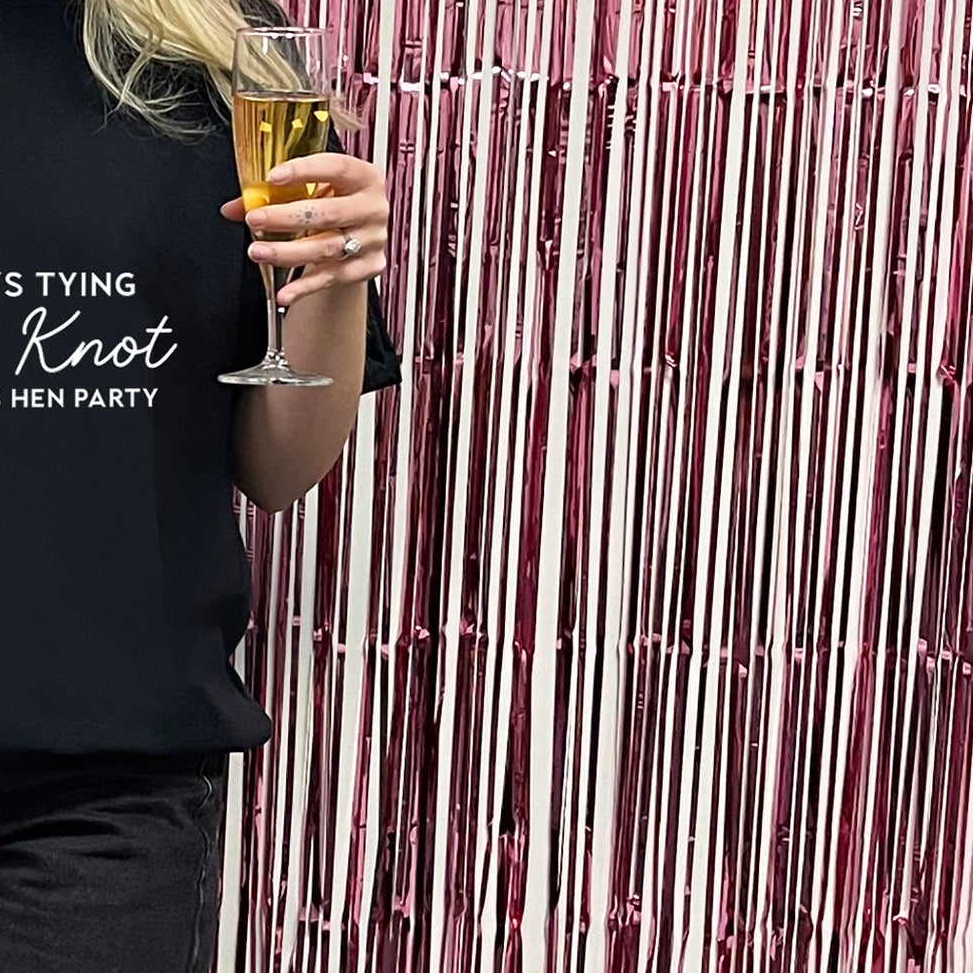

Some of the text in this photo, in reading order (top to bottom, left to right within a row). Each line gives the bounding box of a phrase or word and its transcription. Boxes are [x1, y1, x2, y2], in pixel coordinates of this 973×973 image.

[35, 271, 136, 297] TYING
[14, 306, 178, 376] Knot
[11, 388, 64, 409] HEN
[74, 387, 159, 409] PARTY
